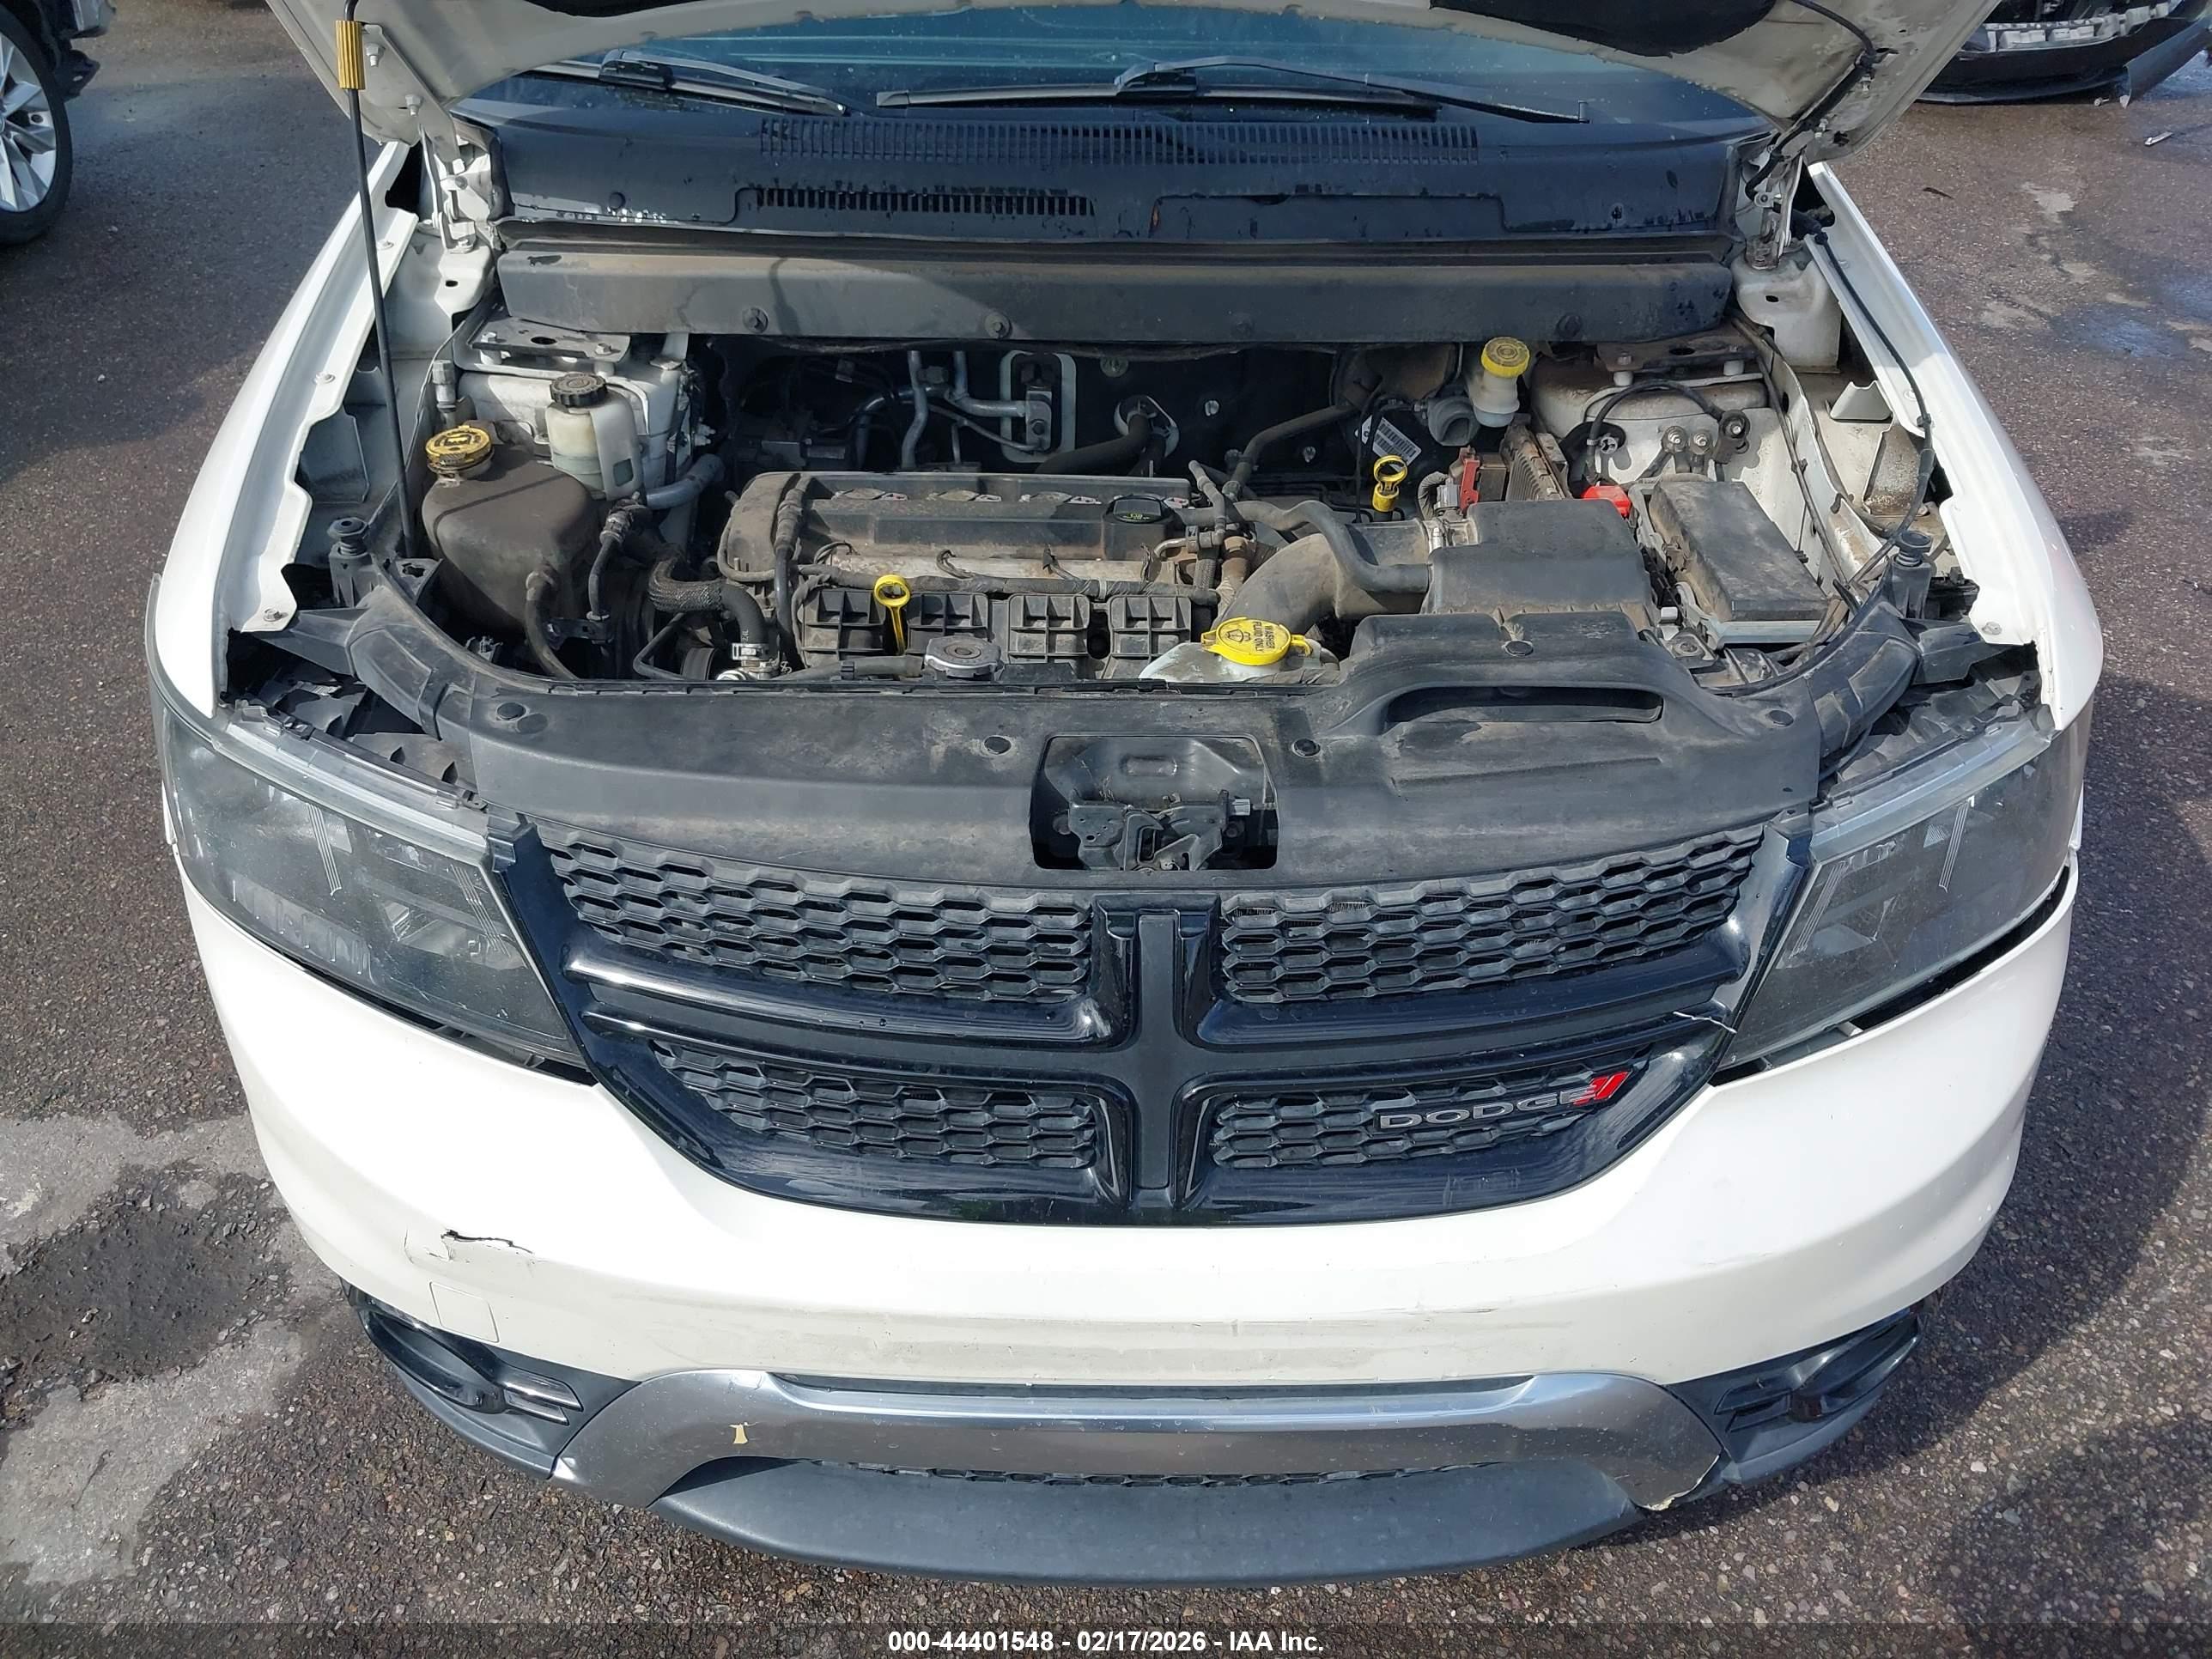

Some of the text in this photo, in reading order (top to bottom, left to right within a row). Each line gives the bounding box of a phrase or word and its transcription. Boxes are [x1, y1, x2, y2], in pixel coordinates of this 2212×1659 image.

[1252, 622, 1265, 652] FLUID ONLY
[1264, 625, 1275, 649] WASHER
[1379, 1085, 1599, 1129] DODGE
